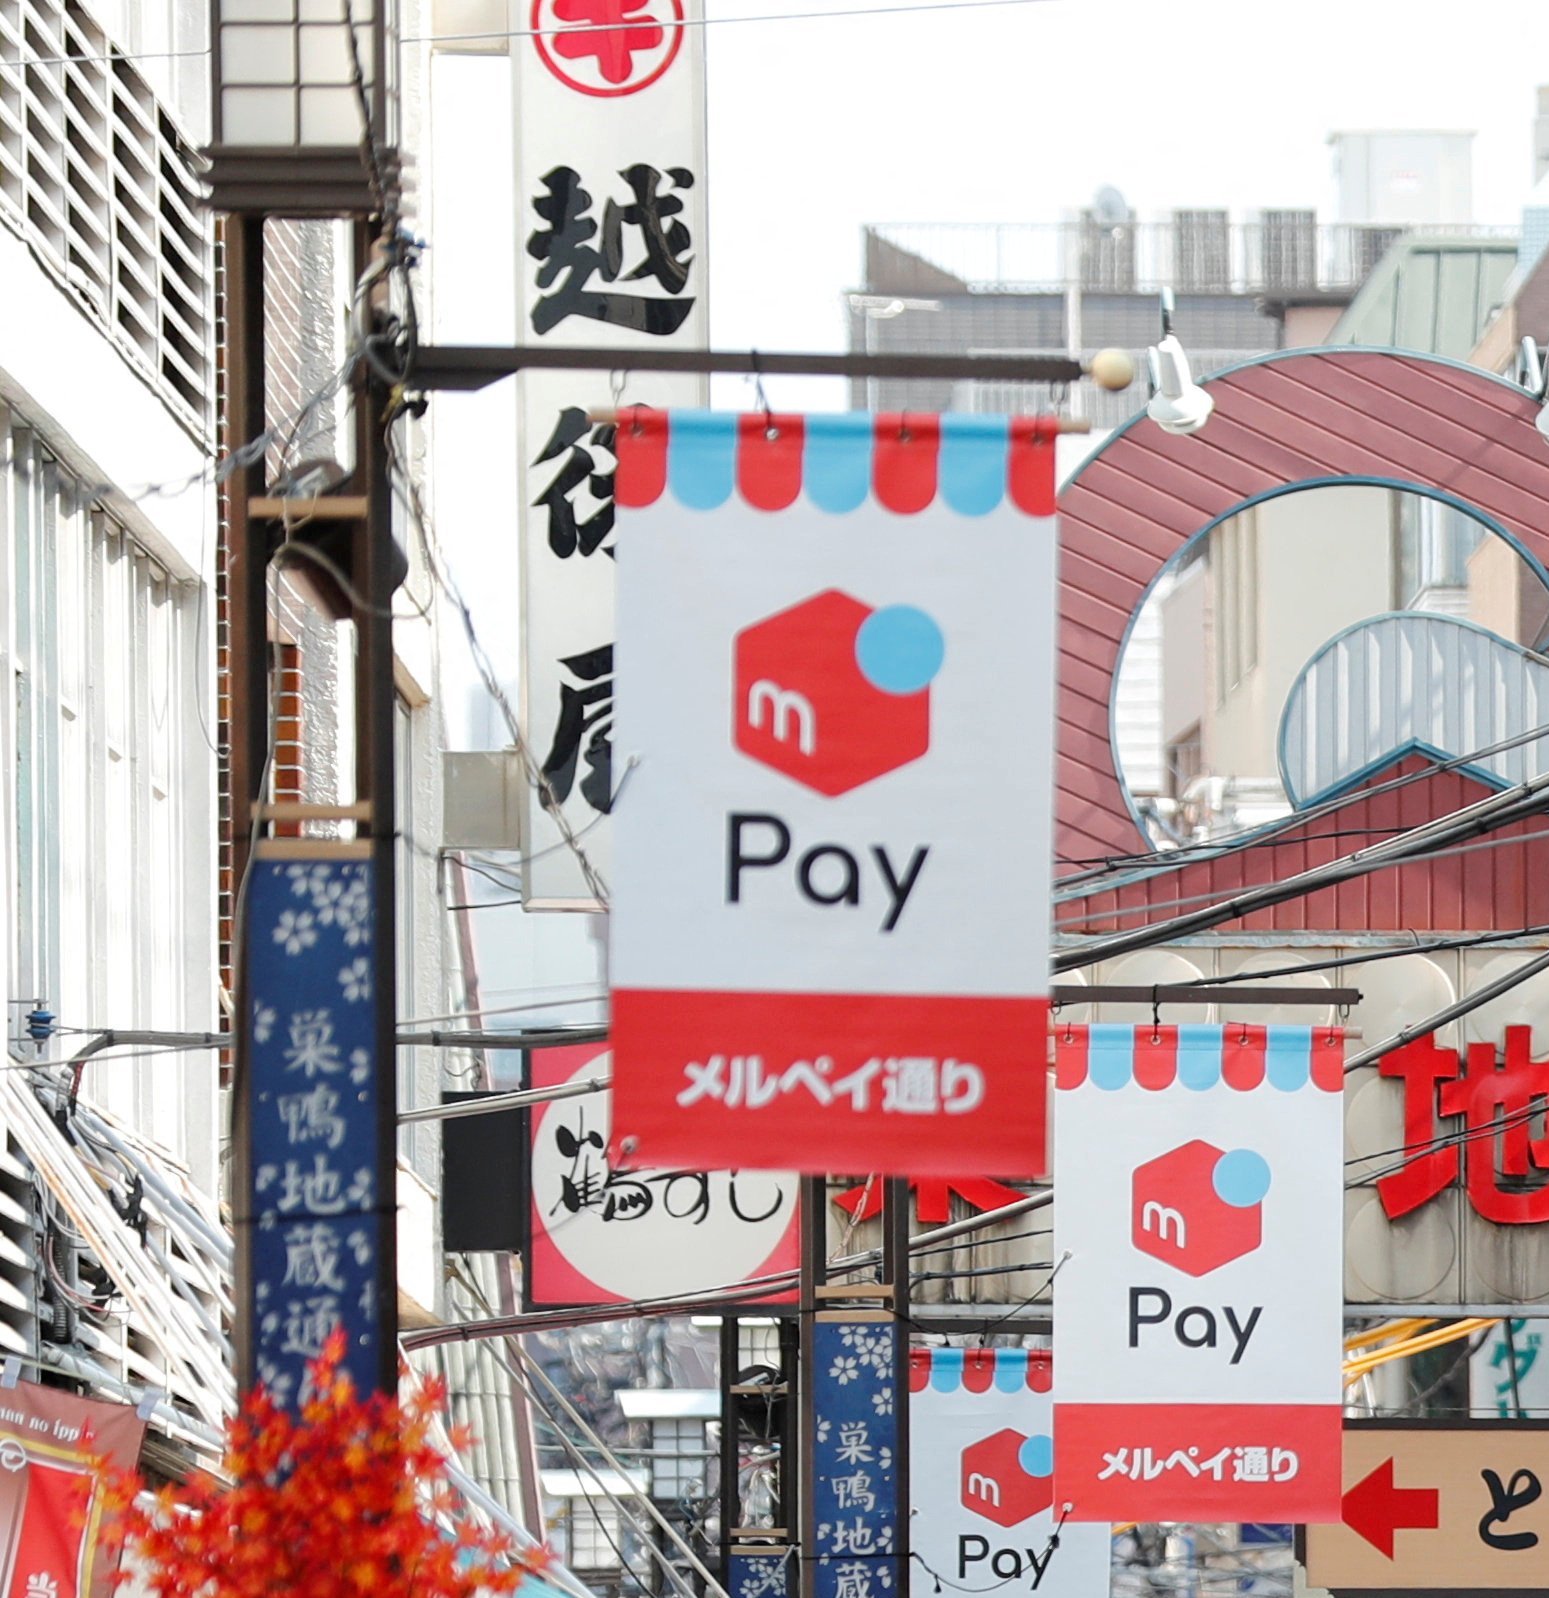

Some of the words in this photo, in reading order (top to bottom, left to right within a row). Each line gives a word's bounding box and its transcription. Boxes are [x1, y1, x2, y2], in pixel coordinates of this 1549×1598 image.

[726, 812, 931, 933] Pay
[677, 1055, 985, 1115] メルペイ通り
[276, 1012, 350, 1400] 巣鴨地蔵通
[1127, 1287, 1264, 1365] Pay
[1097, 1447, 1300, 1483] メルペイ通り
[956, 1534, 1054, 1591] Pay
